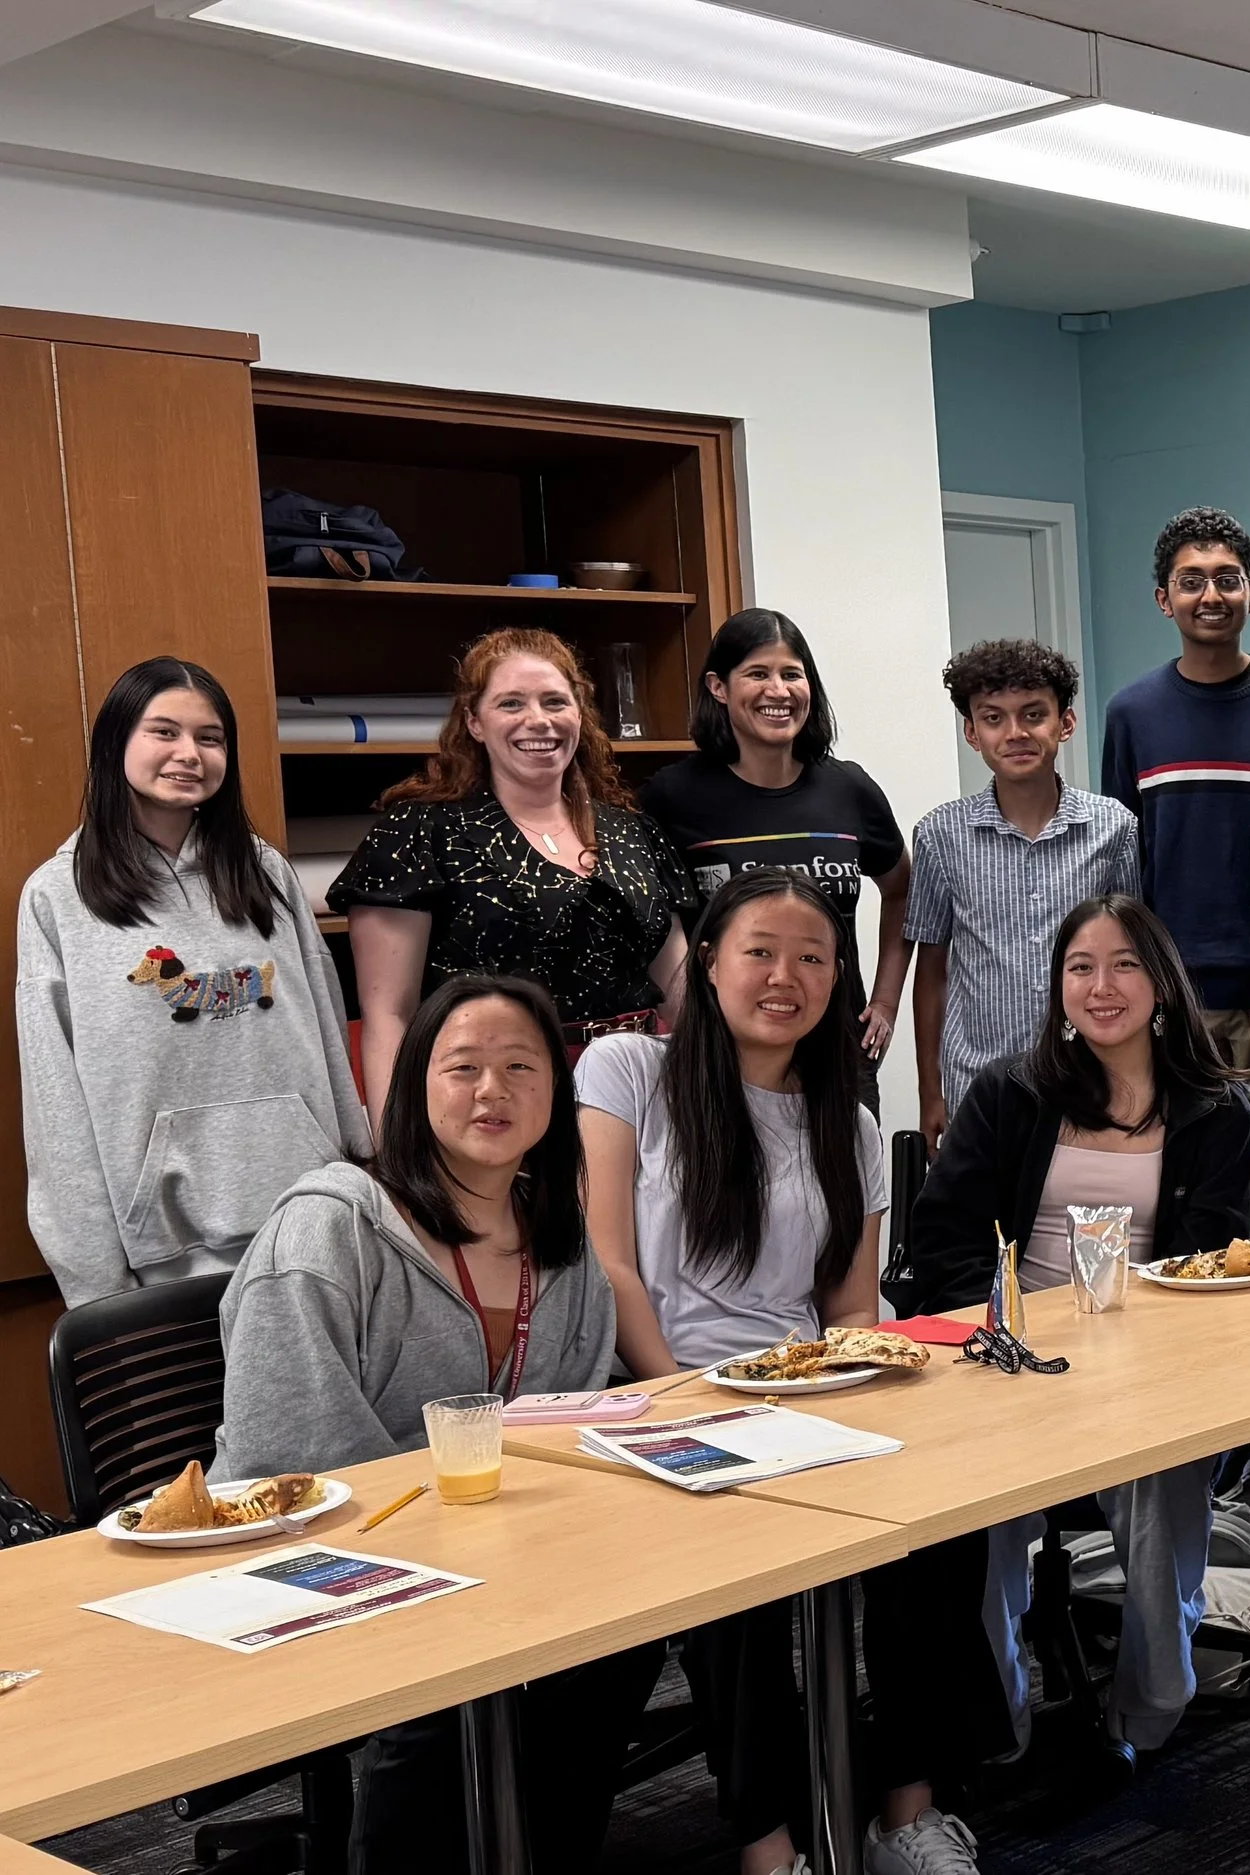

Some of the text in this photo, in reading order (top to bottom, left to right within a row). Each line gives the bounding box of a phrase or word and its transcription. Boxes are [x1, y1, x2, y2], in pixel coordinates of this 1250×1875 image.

[741, 856, 862, 879] Snford
[520, 1297, 529, 1317] Class
[514, 1336, 527, 1377] University
